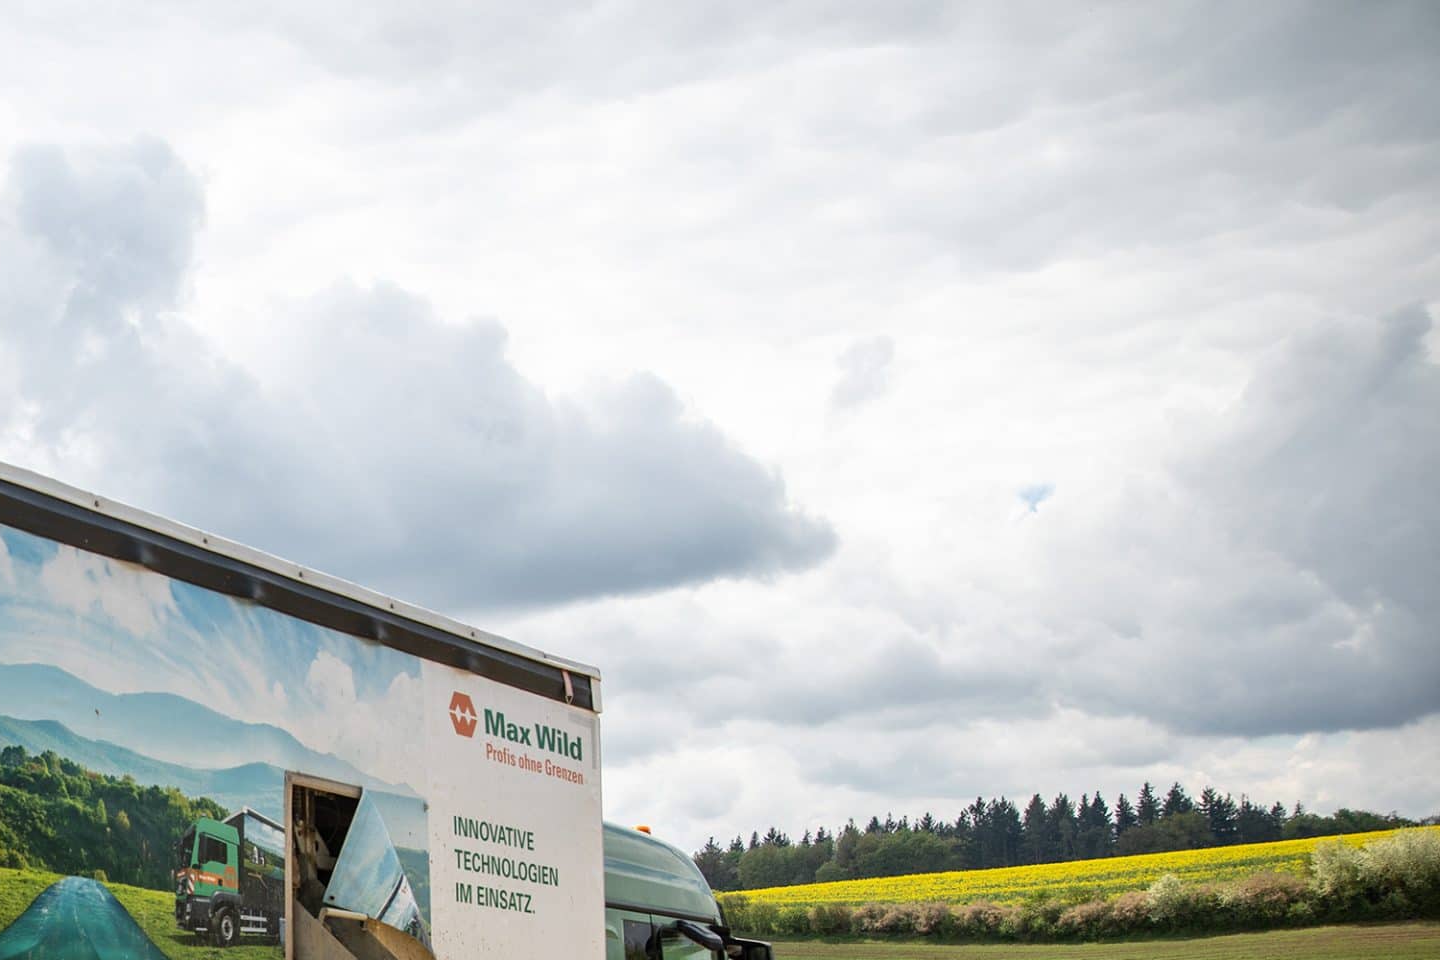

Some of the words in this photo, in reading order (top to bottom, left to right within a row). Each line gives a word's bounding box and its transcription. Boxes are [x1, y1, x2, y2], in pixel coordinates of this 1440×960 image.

[484, 708, 531, 746] Max
[535, 723, 582, 761] Wild
[486, 743, 516, 767] Profis
[518, 754, 542, 774] ohne
[544, 759, 584, 785] Grenzen
[453, 815, 535, 851] INNOVATIVE
[454, 848, 559, 887] TECHNOLOGIEN
[456, 882, 472, 904] IM
[477, 886, 536, 914] EINSATZ.
